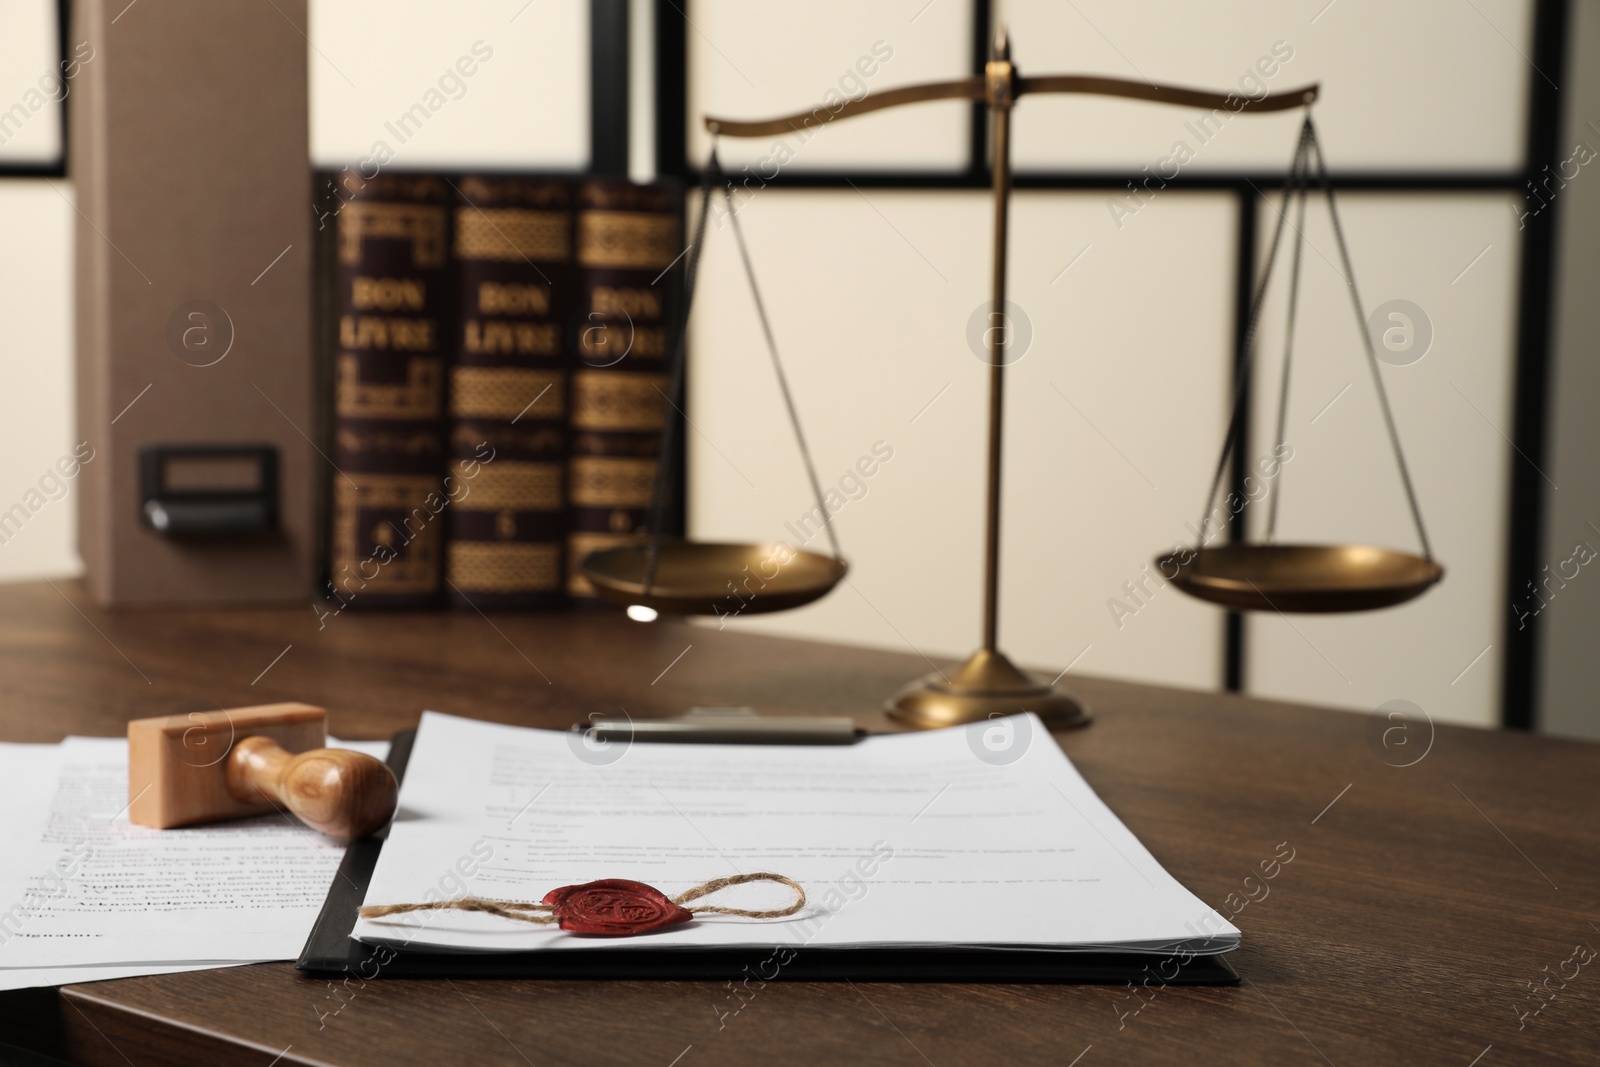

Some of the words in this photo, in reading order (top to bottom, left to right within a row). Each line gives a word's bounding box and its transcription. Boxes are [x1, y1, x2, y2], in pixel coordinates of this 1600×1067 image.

[352, 276, 425, 311] BON
[478, 281, 550, 315] BON
[339, 316, 436, 350] LIVRE
[464, 320, 560, 355] LIVRE
